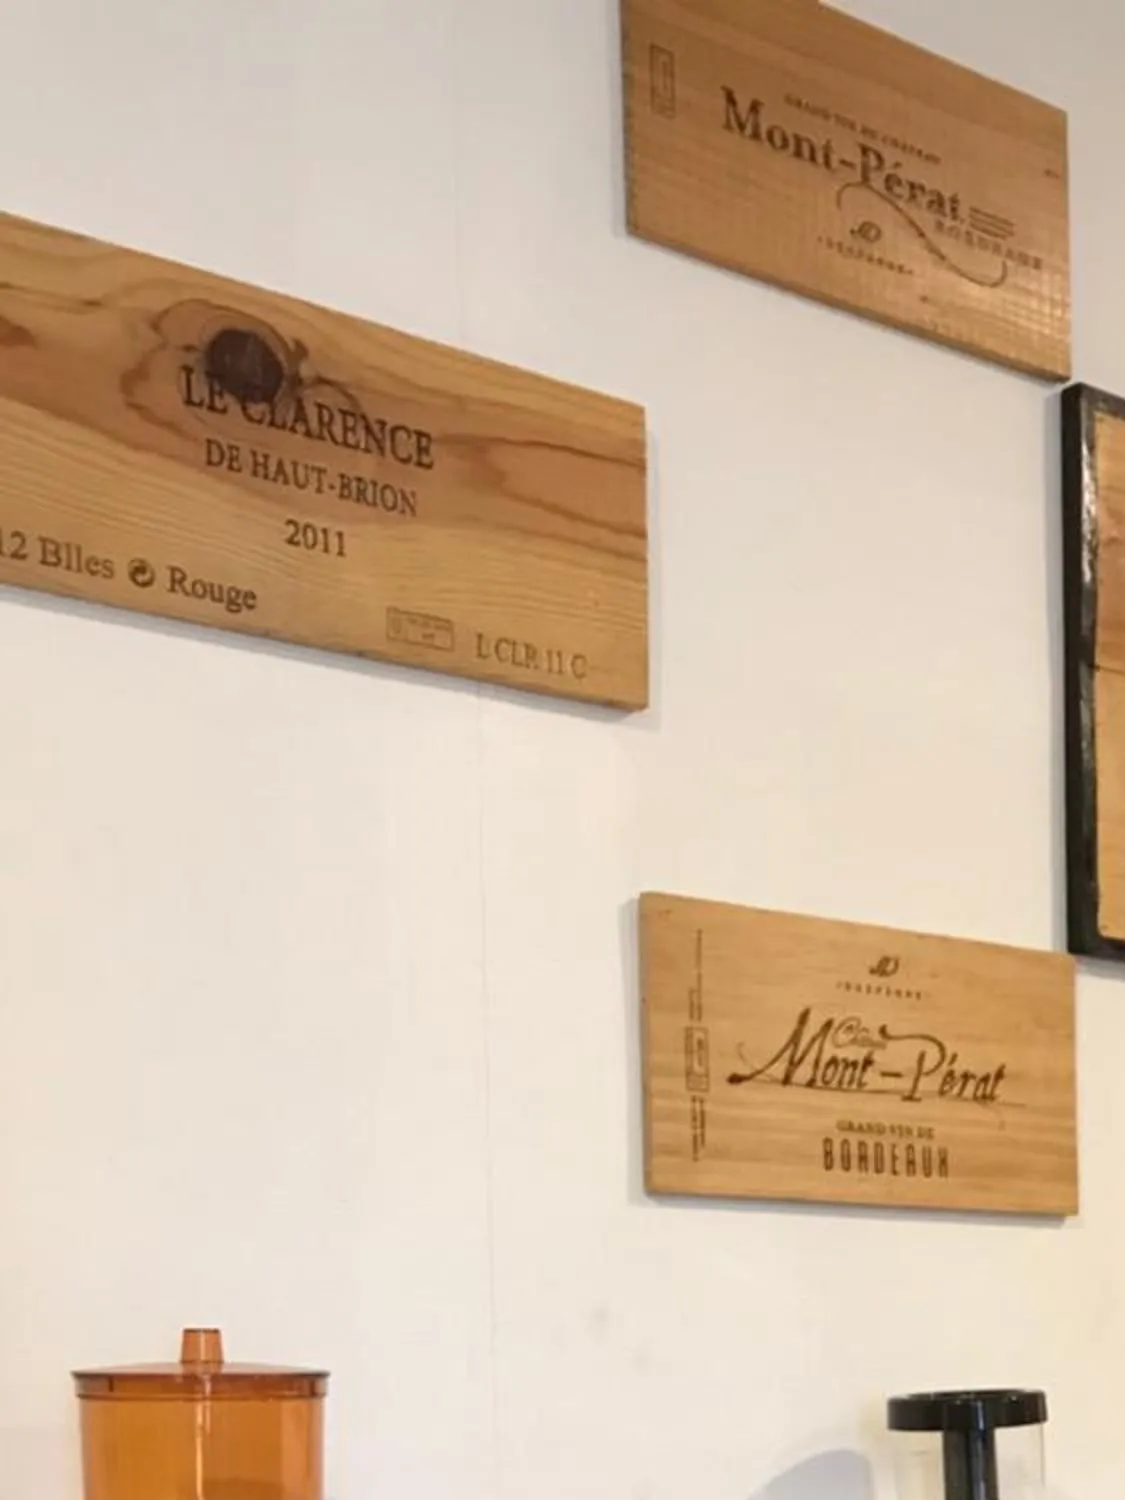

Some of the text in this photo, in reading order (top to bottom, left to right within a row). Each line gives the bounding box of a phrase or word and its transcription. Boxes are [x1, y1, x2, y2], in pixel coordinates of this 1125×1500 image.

[719, 84, 962, 222] Mont-Pérat
[205, 437, 417, 517] DE HAUT-BRION
[284, 518, 348, 558] 2011
[166, 564, 258, 615] Rouge
[822, 1135, 950, 1179] BORDEAUX
